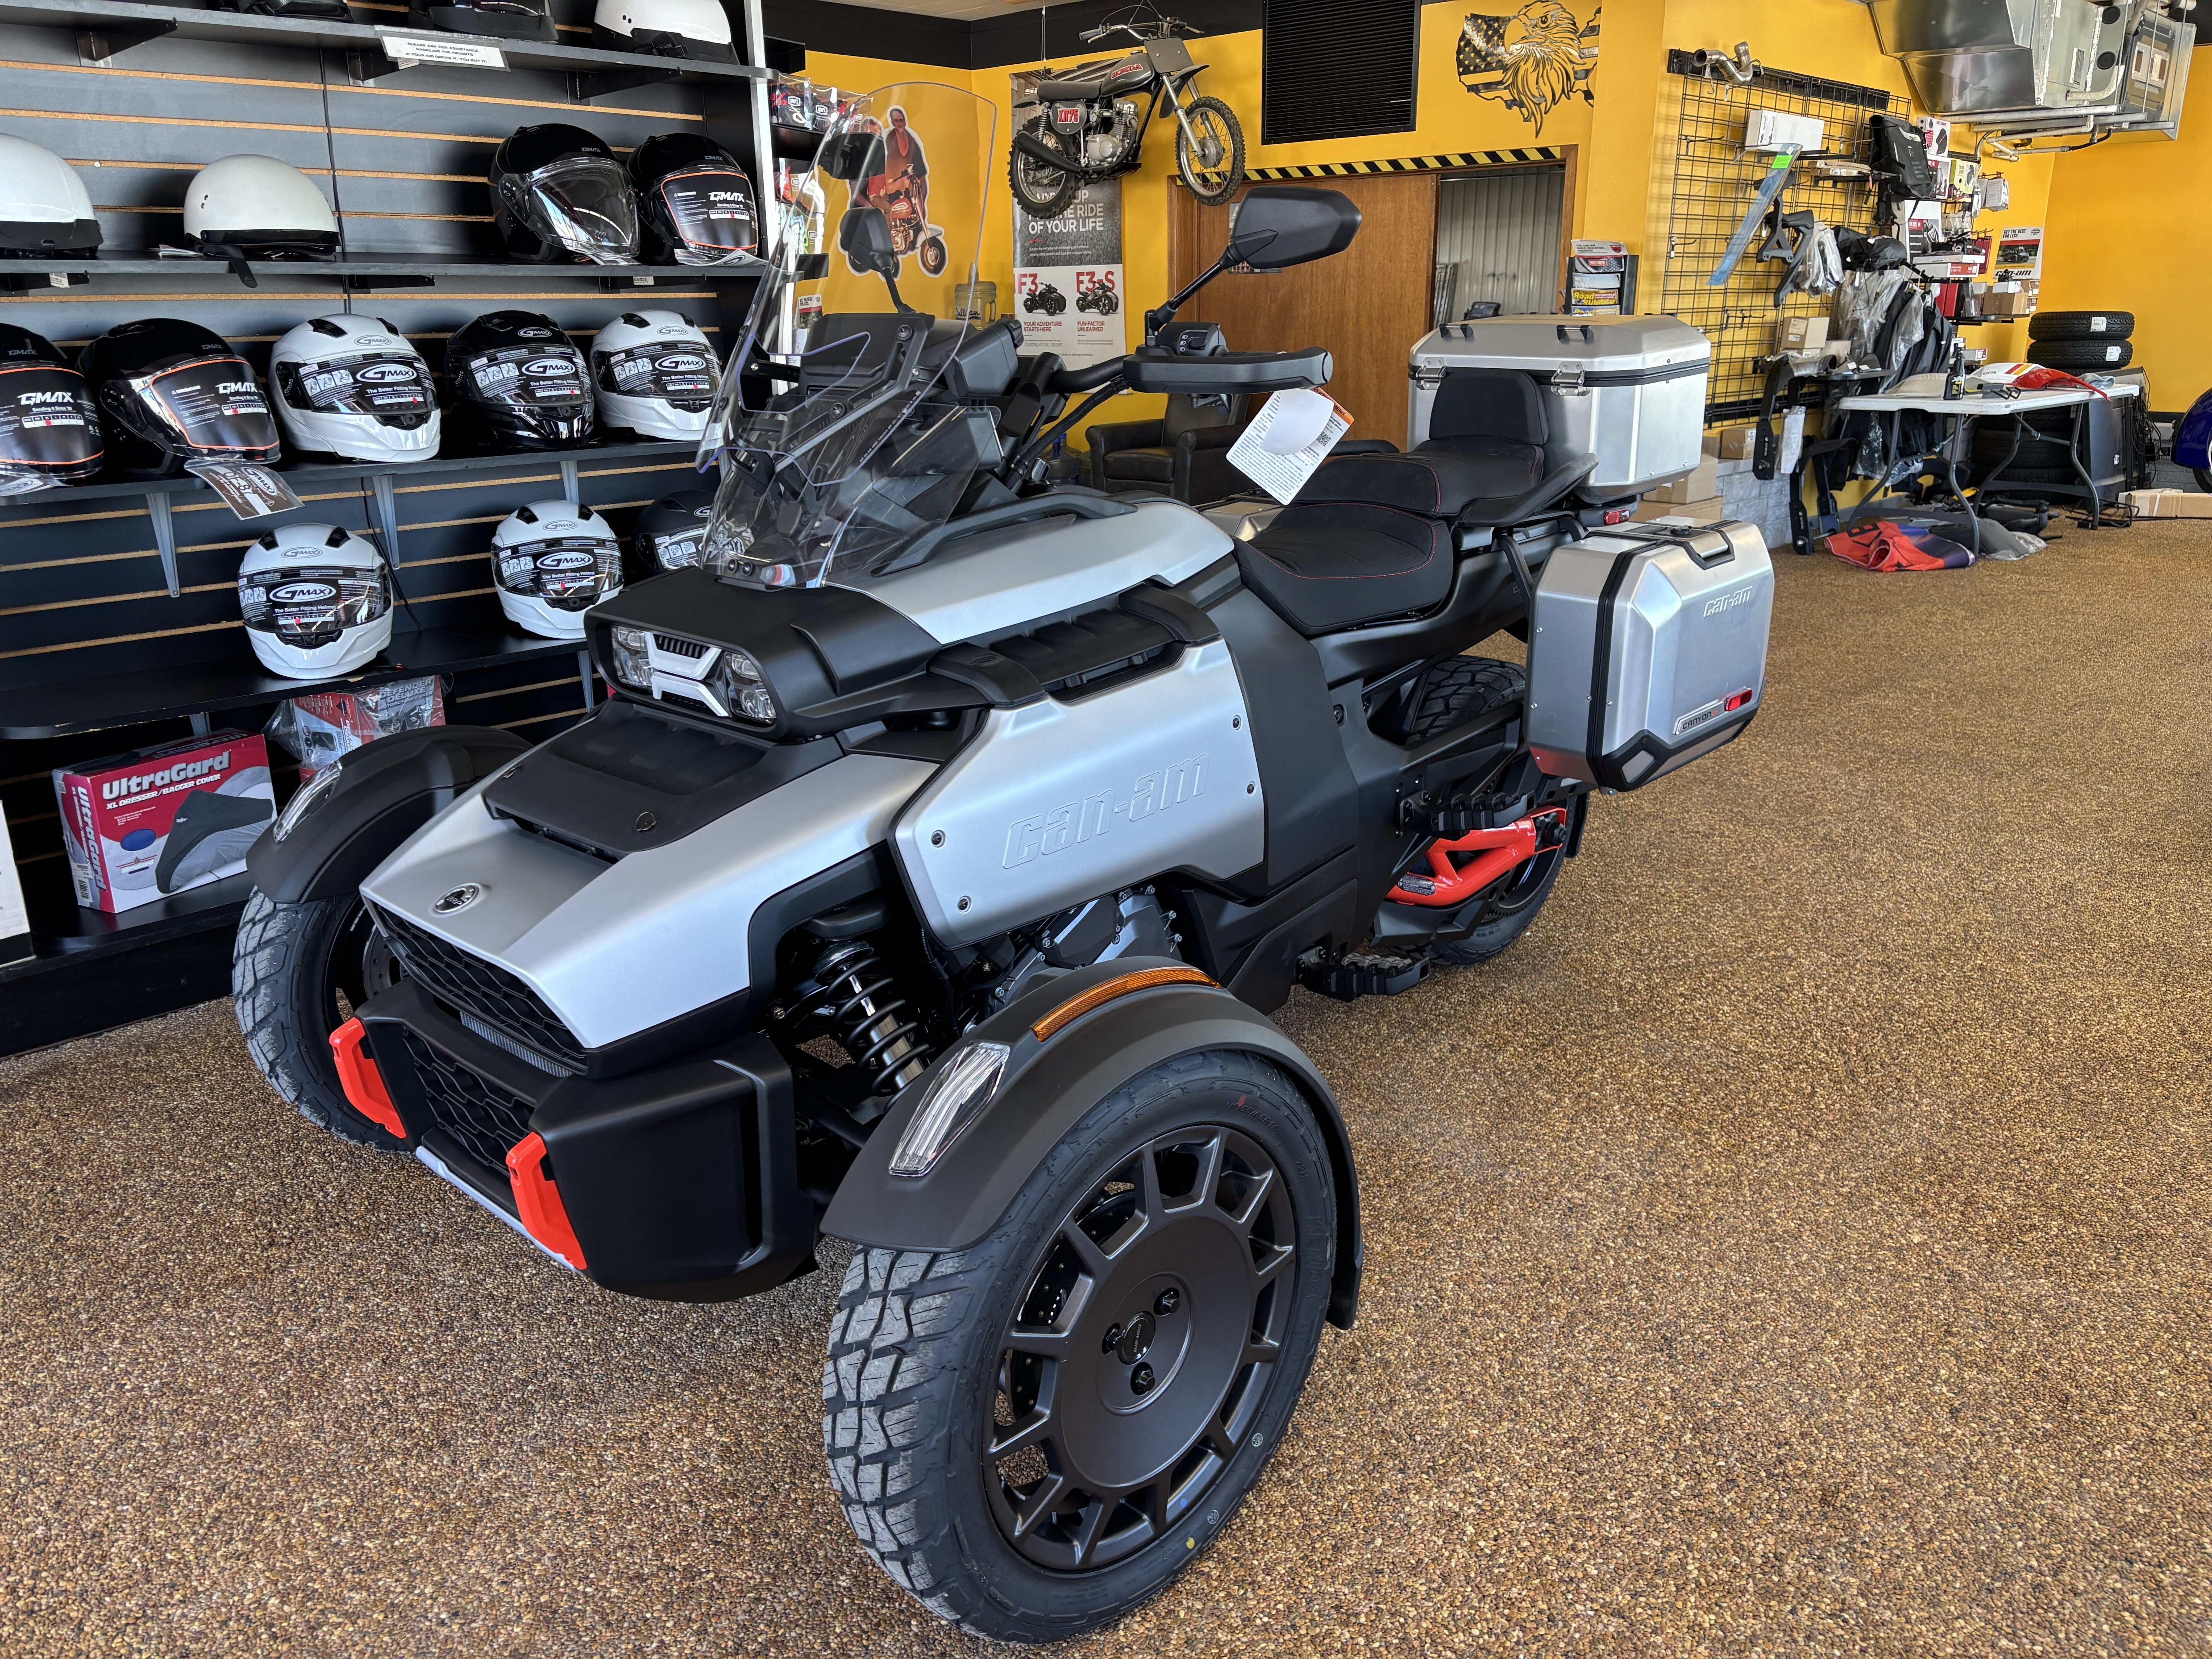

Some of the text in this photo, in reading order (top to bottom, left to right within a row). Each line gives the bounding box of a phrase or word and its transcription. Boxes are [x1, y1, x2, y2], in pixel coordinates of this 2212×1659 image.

[1111, 64, 1143, 79] HONDA
[708, 191, 745, 202] GMAX
[1077, 203, 1104, 217] RIDE
[1029, 218, 1104, 234] OF YOUR LIFE
[1017, 270, 1115, 294] F3 F3-S
[1574, 291, 1595, 299] Road
[519, 328, 551, 337] GMAX
[658, 326, 687, 335] GMAX
[356, 335, 390, 345] GMAX
[522, 359, 574, 376] GMAX
[656, 355, 705, 371] GMAX
[357, 365, 414, 381] GMAX
[215, 382, 258, 394] GMAX
[17, 392, 74, 405] GMAX
[543, 520, 578, 530] GMAX
[282, 548, 322, 558] GMAX
[538, 552, 592, 568] GMAX
[271, 583, 334, 601] GMAX
[1703, 586, 1753, 618] can-am
[378, 679, 433, 699] DEFENDER
[387, 686, 426, 703] DELUXE
[1683, 711, 1712, 730] CANYON
[103, 750, 231, 800] UltraGard
[106, 773, 221, 810] XL DRESSER/BAGGER COVER
[1002, 753, 1209, 869] can-am
[78, 786, 108, 891] UltraGard
[446, 896, 463, 905] BRP
[1306, 1216, 1322, 1298] KENDA
